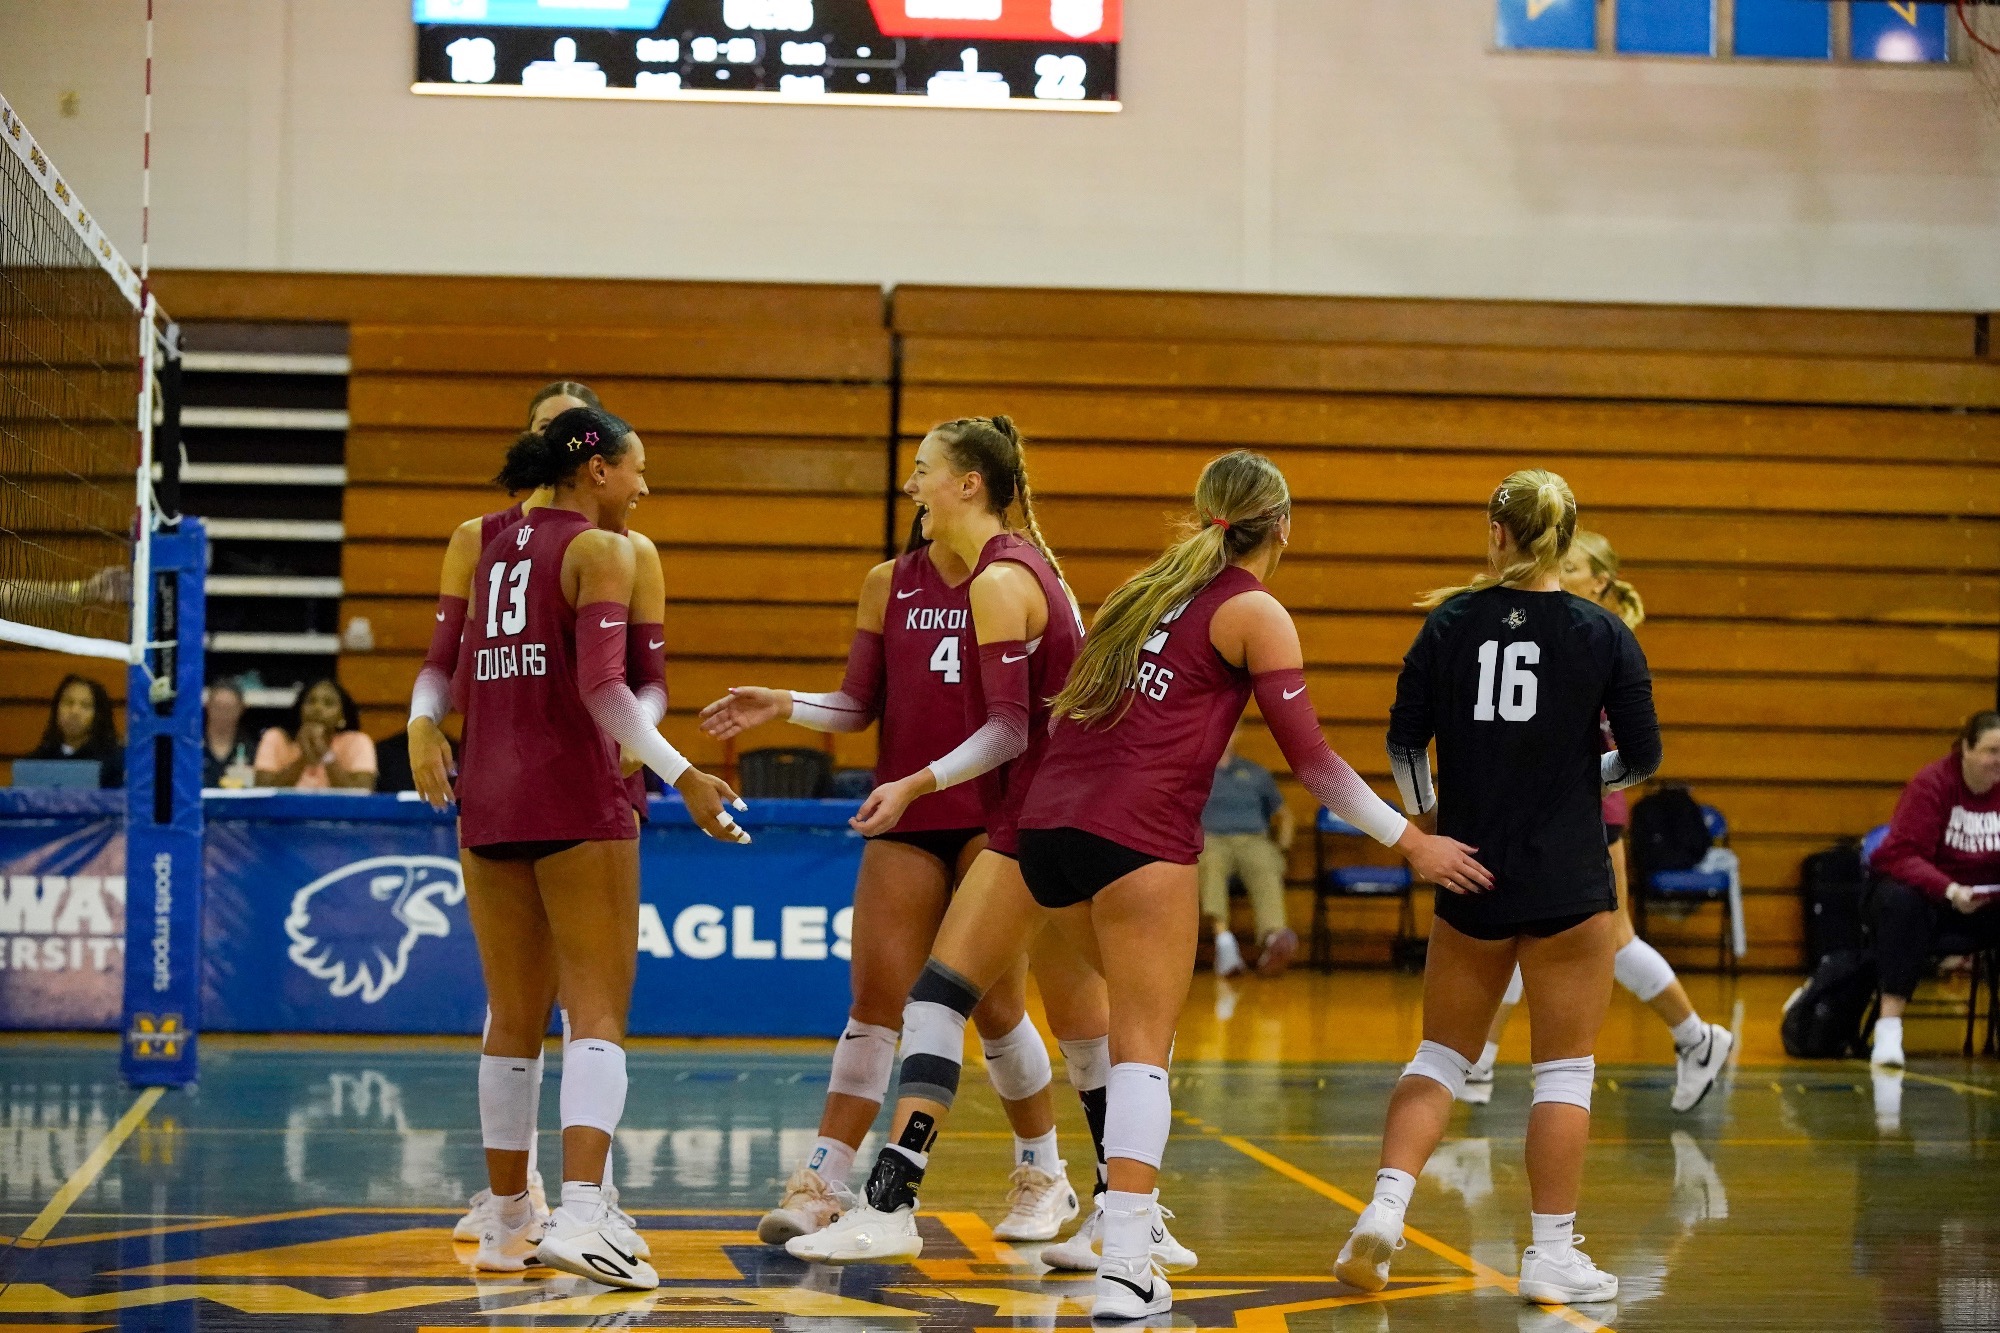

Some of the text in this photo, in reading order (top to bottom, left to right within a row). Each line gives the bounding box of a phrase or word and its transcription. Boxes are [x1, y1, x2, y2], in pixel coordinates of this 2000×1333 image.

[486, 558, 532, 638] 13
[474, 643, 546, 681] OUGARS
[929, 636, 961, 683] 4
[1473, 639, 1541, 722] 16
[0, 936, 125, 970] RSIT
